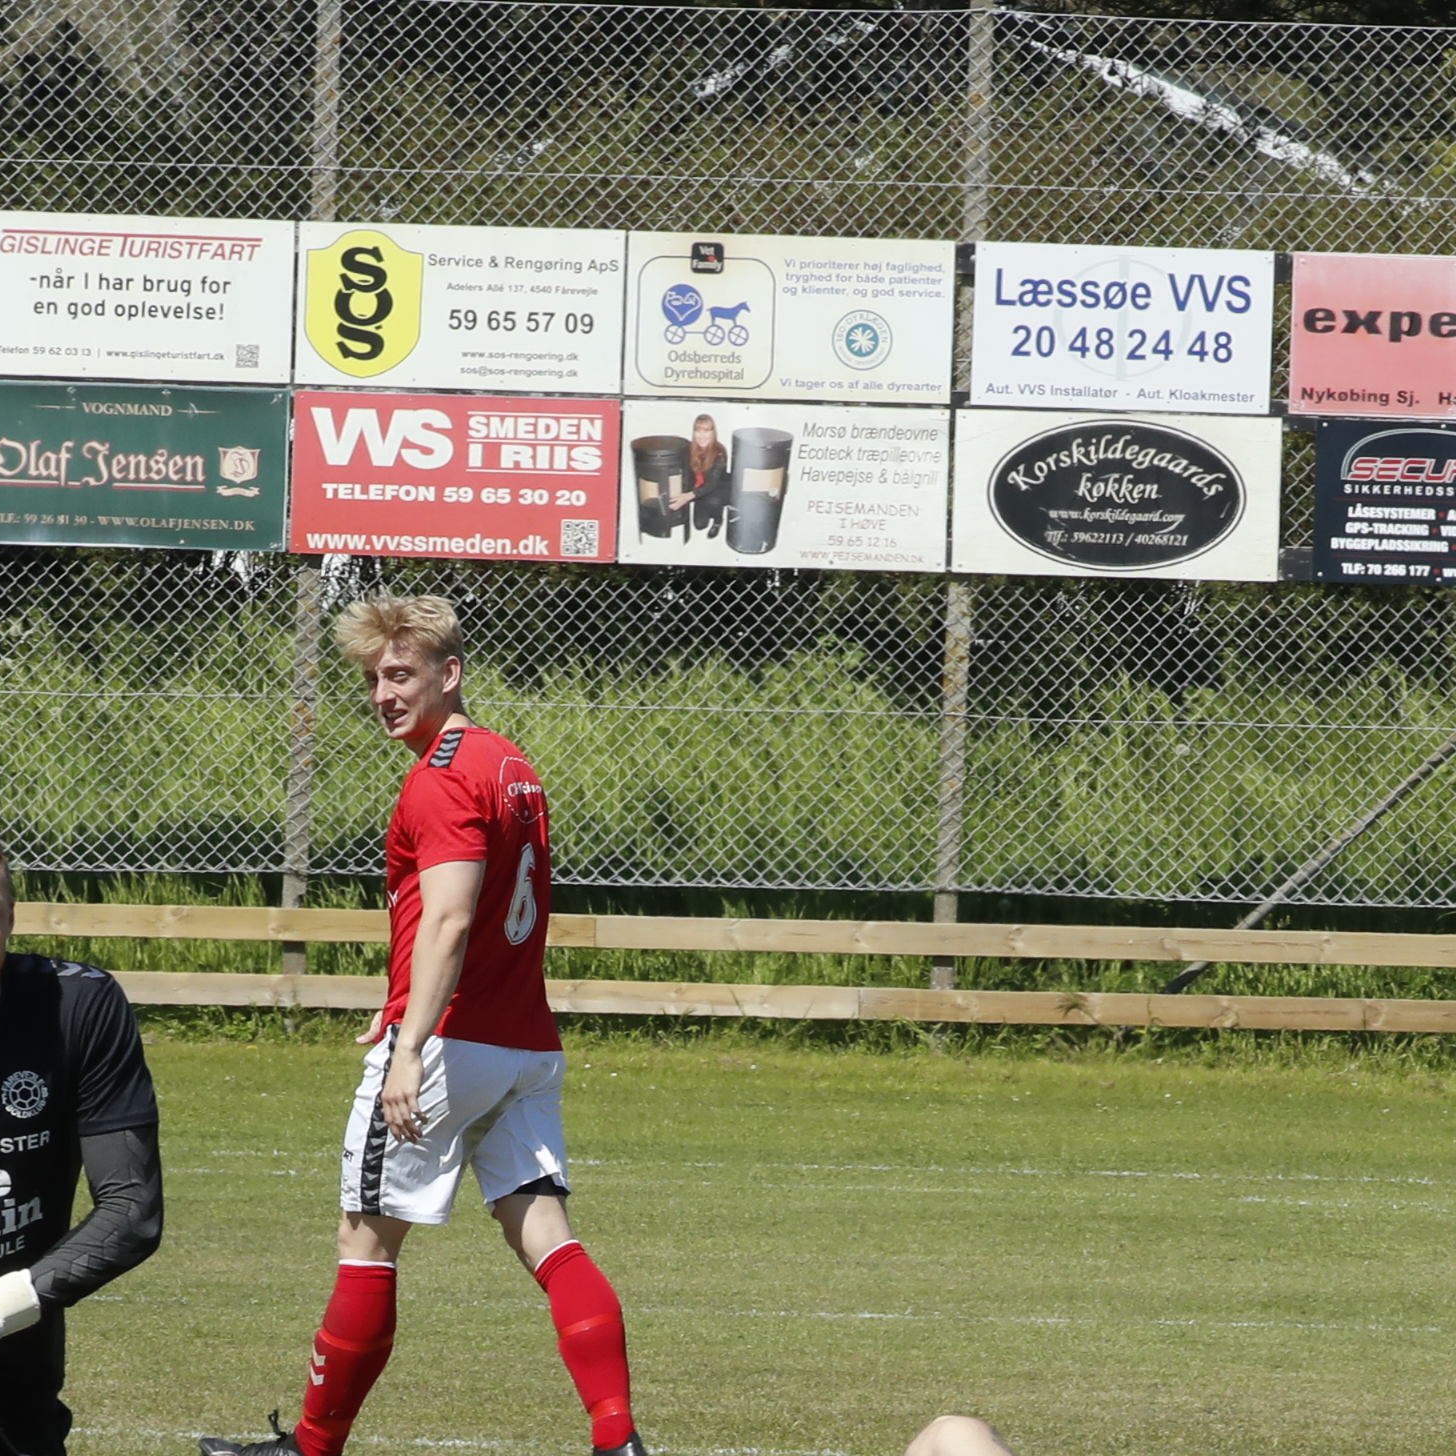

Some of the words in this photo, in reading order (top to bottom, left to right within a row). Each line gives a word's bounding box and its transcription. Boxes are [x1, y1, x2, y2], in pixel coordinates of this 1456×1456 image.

[0, 235, 113, 256] GISLINGE
[119, 236, 261, 261] TURISTFART
[428, 254, 483, 268] Service
[489, 256, 498, 268] &
[504, 256, 582, 273] Rengøring
[588, 259, 619, 275] ApS
[800, 260, 859, 273] prioriterer
[98, 273, 134, 291] har
[143, 275, 191, 296] brug
[201, 276, 231, 294] for
[786, 273, 832, 286] tryghed
[836, 273, 852, 283] for
[857, 273, 885, 285] både
[889, 276, 942, 287] patienter
[853, 288, 867, 297] og
[872, 287, 894, 298] god
[995, 268, 1151, 310] Læssøe
[1168, 273, 1252, 314] VVS
[34, 303, 58, 315] en
[67, 300, 105, 319] god
[115, 301, 225, 321] oplevelse!
[448, 310, 477, 330] 59
[487, 311, 516, 331] 65
[526, 312, 555, 333] 57
[565, 313, 594, 334] 09
[33, 346, 45, 355] 59
[49, 347, 62, 355] 62
[1011, 325, 1056, 357] 20
[1068, 327, 1114, 360] 48
[1126, 329, 1173, 361] 24
[1187, 331, 1232, 363] 48
[664, 367, 744, 382] Dyrehospital
[796, 379, 825, 391] tager
[862, 381, 883, 390] alle
[887, 381, 942, 393] dyrearter
[986, 383, 1012, 395] Aut.
[1018, 385, 1046, 396] VVS
[1051, 385, 1118, 398] Installatør
[1137, 389, 1164, 400] Aut.
[1169, 389, 1255, 403] Kloakmester
[1301, 388, 1389, 406] Nykøbing
[1397, 391, 1419, 405] Sj.
[82, 402, 173, 416] VOGNMAND
[468, 416, 602, 441] SMEDEN
[803, 422, 845, 439] Morsø
[851, 424, 938, 441] brændeovne
[311, 407, 454, 470] VVS
[500, 445, 602, 471] RIIS
[798, 445, 853, 461] Ecoteck
[82, 442, 206, 486] Jensen
[1007, 435, 1226, 496] Korskildegaards
[800, 467, 873, 487] Havepejse
[322, 483, 435, 501] TELEFON
[443, 487, 474, 503] 59
[481, 487, 511, 504] 65
[518, 489, 549, 505] 30
[555, 490, 587, 506] 20
[1078, 473, 1159, 503] køkken
[807, 501, 919, 517] PEJSEMANDEN
[1348, 503, 1435, 520] LÅSESYSTEMER
[98, 515, 255, 531] WWW.OLAFJENSEN.DK
[850, 519, 887, 531] HØVE
[1345, 523, 1429, 536] GPS-TRACKING
[307, 533, 549, 555] www.vvssmeden.dk
[828, 535, 844, 546] 59
[847, 536, 863, 547] 65
[1071, 533, 1124, 544] 59622113
[1331, 537, 1448, 552] BYGGEPLADSSIKRING
[1409, 565, 1430, 576] 177
[504, 842, 537, 945] 6
